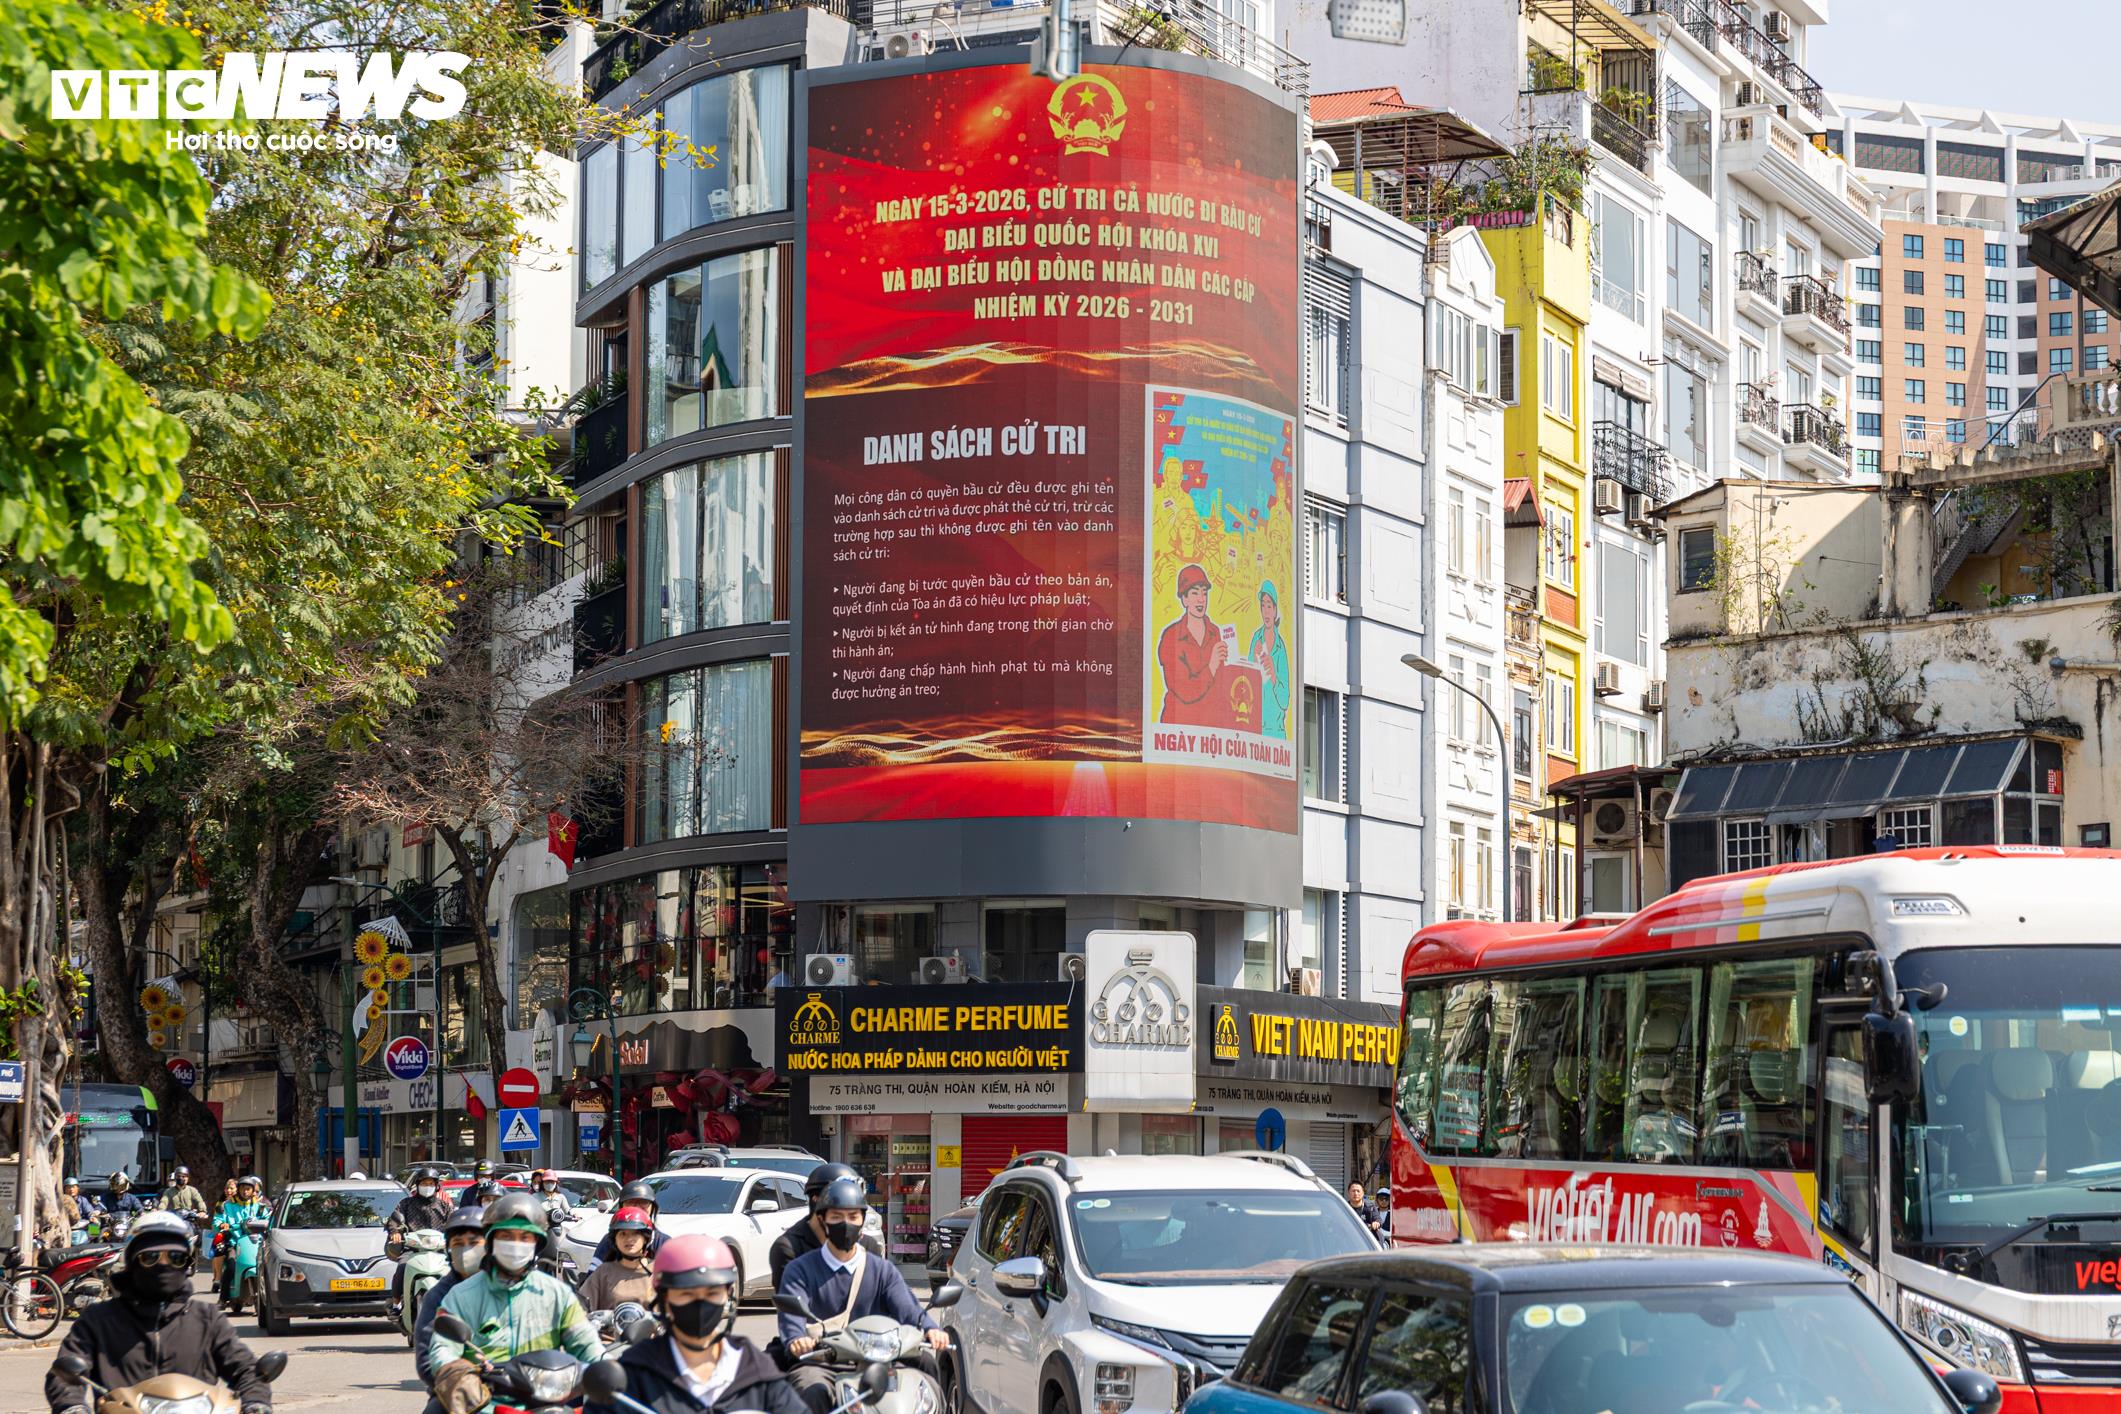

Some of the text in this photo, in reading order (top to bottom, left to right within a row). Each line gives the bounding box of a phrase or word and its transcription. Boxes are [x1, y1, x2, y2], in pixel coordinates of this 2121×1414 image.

[876, 182, 1262, 238] NGÀY 15-3-2026, CỬ TRI CẢ NƯỚC ĐI BẦU CỬ
[944, 216, 1218, 259] ĐẠI BIỂU QUỐC HỘI KHÓA XVI
[882, 252, 1255, 303] VÀ ĐẠI BIỂU HỘI ĐỒNG NHÂN DÂN CÁC CẤP
[974, 292, 1036, 321] NHIỆM
[1044, 291, 1070, 316] KỲ
[1077, 295, 1130, 319] 2026
[1150, 300, 1194, 325] 2031
[864, 418, 1085, 465] DANH SÁCH CỬ TRI
[834, 480, 1113, 506] Mọi công dân có quyền bầu cử đều được ghi tên
[834, 499, 1113, 524] vào danh sách cử tri và được phát thẻ cử tri, trừ các
[834, 519, 1113, 543] trường hợp sau thì không được ghi tên vào danh
[834, 547, 890, 562] sách cử tri:
[843, 572, 1113, 598] Người đang bị tước quyền bầu cử theo bản án,
[833, 592, 1091, 617] quyết định của Tòa án đã có hiệu lực pháp luật;
[843, 617, 1113, 641] Người bị kết án tử hình đang trong thời gian chờ
[832, 644, 894, 658] thi hành án;
[1154, 730, 1291, 767] NGÀY HỘI CỦA TOÀN DÂN
[850, 1004, 1069, 1032] CHARME PERFUME
[790, 1031, 840, 1044] CHARME
[1092, 1022, 1191, 1045] CHARME
[1250, 1013, 1294, 1056] VIET
[1297, 1018, 1338, 1060] NAM
[389, 1044, 423, 1064] Vikki
[788, 1045, 1069, 1070] NƯỚC HOA PHÁP DÀNH CHO NGƯỜI VIỆT
[829, 1080, 1055, 1096] 75 TRÀNG THI, QUẬN HOÀN KIẾM, HÀ NỘI
